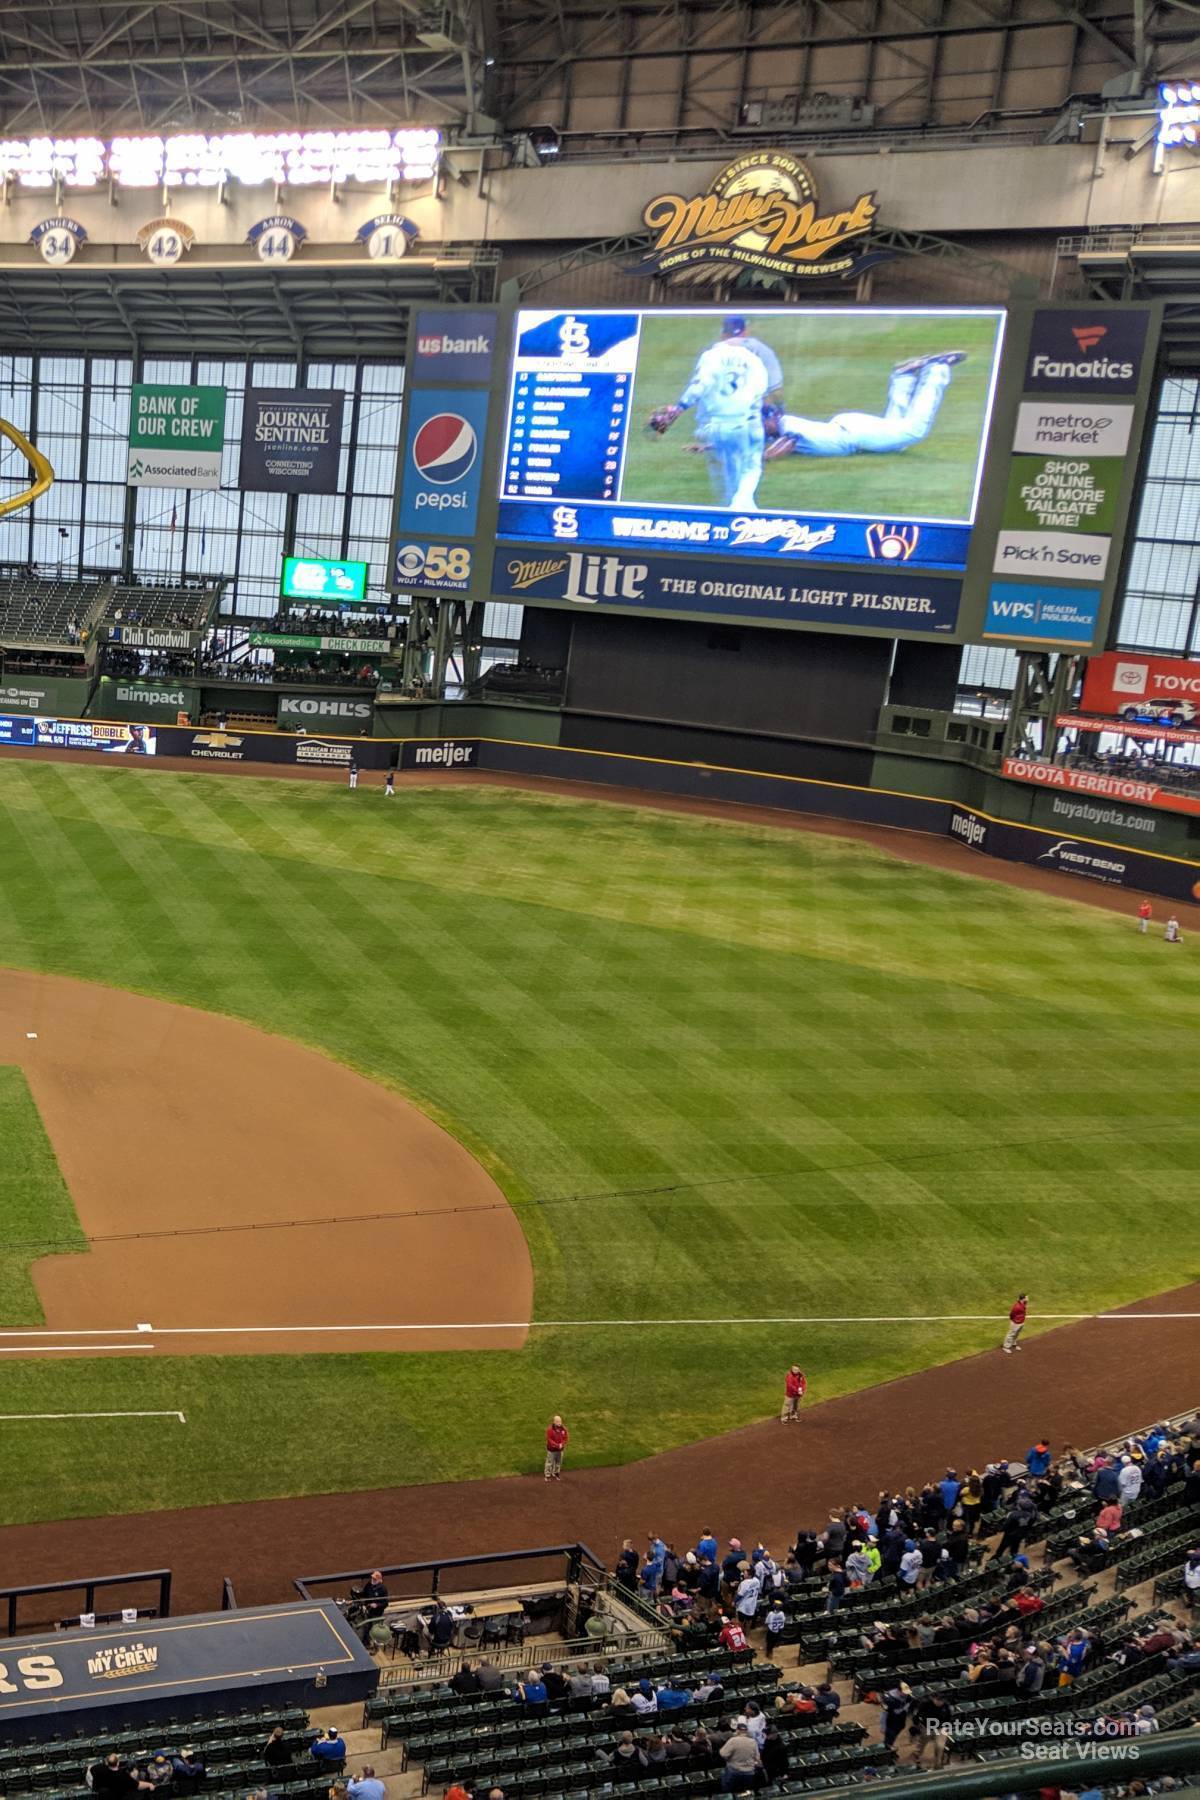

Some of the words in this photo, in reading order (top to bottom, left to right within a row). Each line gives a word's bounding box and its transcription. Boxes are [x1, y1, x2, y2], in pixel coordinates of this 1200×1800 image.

[727, 154, 768, 178] SINCE
[772, 154, 799, 176] 2001
[40, 218, 78, 232] FINGERS
[262, 217, 293, 230] AARON
[374, 215, 404, 226] SELIG
[644, 191, 788, 255] Miller
[751, 191, 879, 261] Park
[46, 236, 71, 257] 34
[152, 236, 177, 257] 42
[262, 235, 289, 257] 44
[384, 234, 393, 257] 1
[659, 252, 689, 269] HOME
[691, 248, 706, 259] OF
[710, 248, 731, 258] THE
[732, 250, 794, 273] MILWAUKEE
[797, 259, 854, 275] BREWERS
[1031, 355, 1134, 379] Fanatics
[138, 396, 177, 415] BANK
[181, 397, 199, 416] OF
[138, 418, 166, 436] OUR
[171, 419, 214, 438] CREW
[255, 411, 330, 428] JOURNAL
[1037, 414, 1093, 429] metro
[255, 427, 329, 444] SENTINEL
[1035, 428, 1099, 444] market
[264, 443, 319, 452] jsonline.com
[265, 459, 314, 469] CONNECTING
[268, 468, 310, 476] WISCONSIN
[1044, 461, 1090, 478] SHOP
[1035, 474, 1095, 489] ONLINE
[415, 491, 468, 511] pepsi
[1020, 486, 1053, 499] FOR
[1056, 488, 1105, 503] MORE
[1025, 499, 1097, 515] TAILGATE
[1037, 512, 1080, 527] TIME!
[612, 517, 711, 541] WELCOME
[713, 526, 729, 541] TO
[730, 517, 798, 545] Miller
[779, 524, 836, 552] Park
[424, 546, 471, 582] 58
[1057, 549, 1102, 566] Save
[507, 550, 568, 589] Miller
[561, 552, 646, 603] Lite
[397, 577, 417, 585] WDJT
[423, 578, 468, 589] MILWAUKEE
[661, 577, 697, 595] THE
[700, 580, 786, 603] ORIGINAL
[790, 586, 847, 607] LIGHT
[853, 593, 937, 615] PILSNER.
[992, 600, 1035, 619] WPS
[1042, 603, 1078, 614] HEALTH
[1040, 612, 1093, 625] INSURANCE
[122, 627, 144, 646] Club
[146, 629, 190, 649] Goodwill
[328, 638, 358, 650] CHECK
[360, 640, 385, 651] DECK
[128, 687, 185, 705] impact
[280, 699, 372, 718] KOHL'S
[49, 722, 92, 737] JEFFRESS
[93, 726, 125, 738] BOBBLE
[1056, 718, 1093, 728] COURTESY
[1167, 731, 1194, 741] TOYOTA
[191, 749, 244, 759] CHEVROLET
[297, 745, 329, 753] AMERICAN
[416, 743, 473, 767] meijer
[1006, 761, 1065, 785] TOYOTA
[1069, 773, 1159, 801] TERRITORY
[1053, 798, 1156, 833] buyatoyota.com
[951, 813, 987, 845] meijer
[1060, 850, 1092, 865] WEST
[1092, 858, 1126, 873] BEND
[87, 1653, 113, 1674] MY
[115, 1646, 158, 1669] CREW
[95, 1648, 124, 1658] THIS
[128, 1643, 145, 1653] IS
